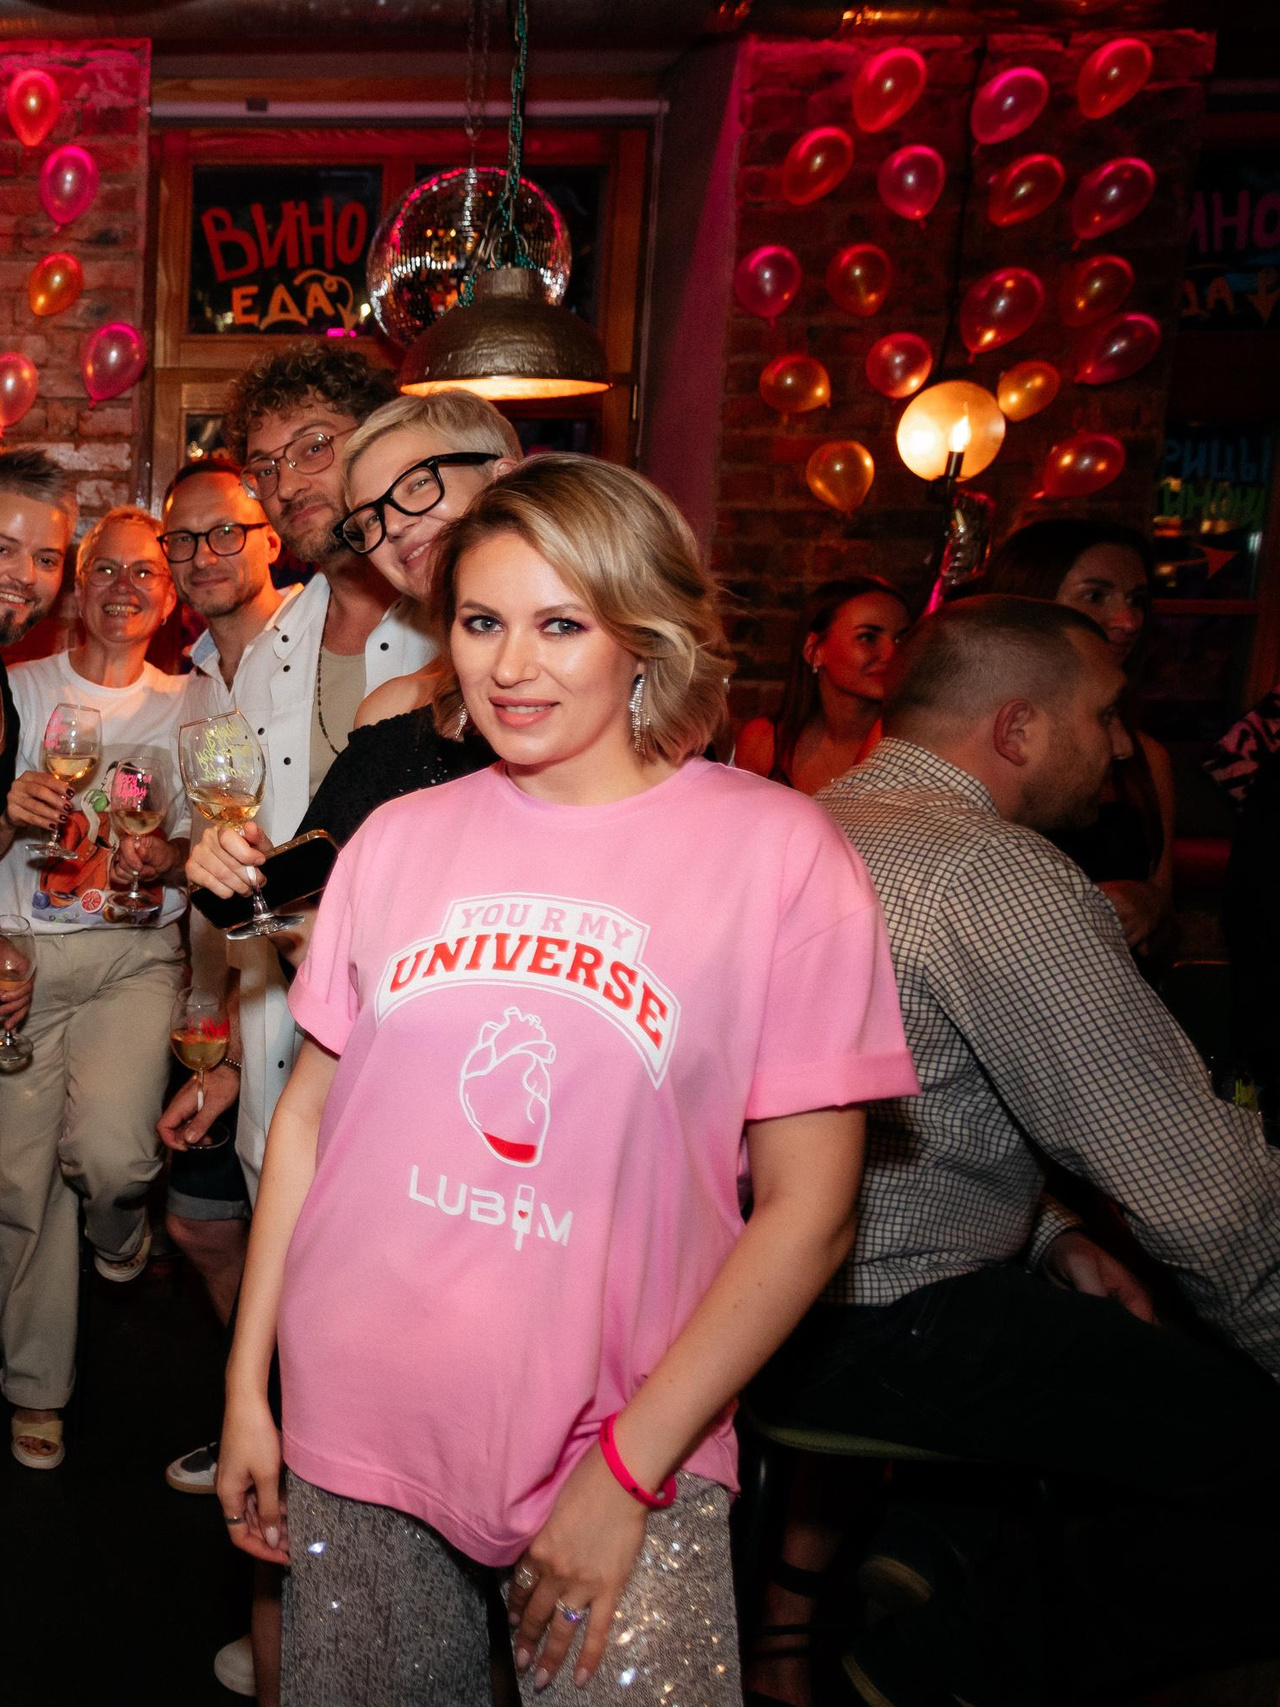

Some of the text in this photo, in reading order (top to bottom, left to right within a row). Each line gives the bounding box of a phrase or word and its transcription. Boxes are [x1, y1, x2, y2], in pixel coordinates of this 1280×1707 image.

[201, 196, 368, 283] ВИНО
[230, 282, 336, 331] ЕДА
[460, 903, 634, 951] YOU R MY
[389, 932, 670, 1051] UNIVERSE
